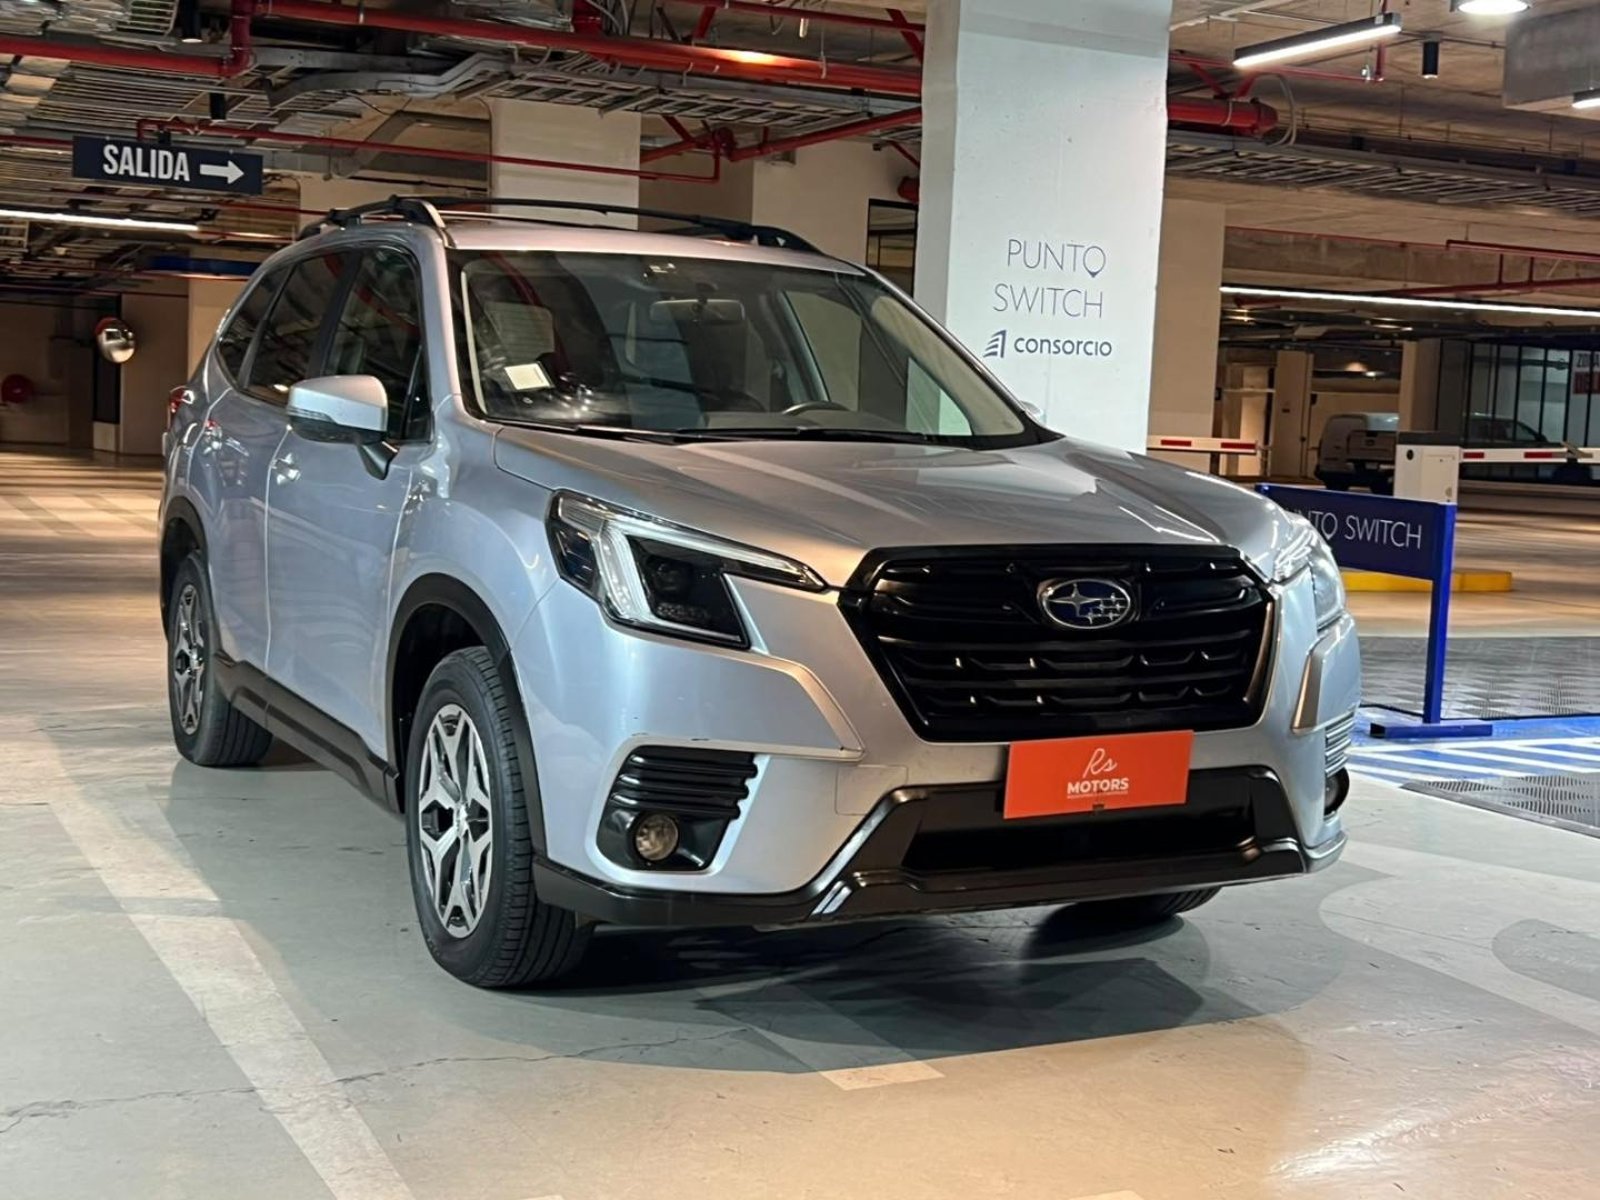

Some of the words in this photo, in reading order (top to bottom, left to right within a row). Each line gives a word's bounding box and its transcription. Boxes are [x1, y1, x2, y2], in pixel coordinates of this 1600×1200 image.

[103, 144, 190, 182] SALIDA
[1007, 239, 1106, 278] PUNTO
[993, 283, 1103, 318] SWITCH
[1014, 337, 1112, 357] consorcio
[1344, 514, 1422, 549] SWITCH
[1082, 748, 1118, 778] Rs
[1066, 777, 1129, 794] MOTORS
